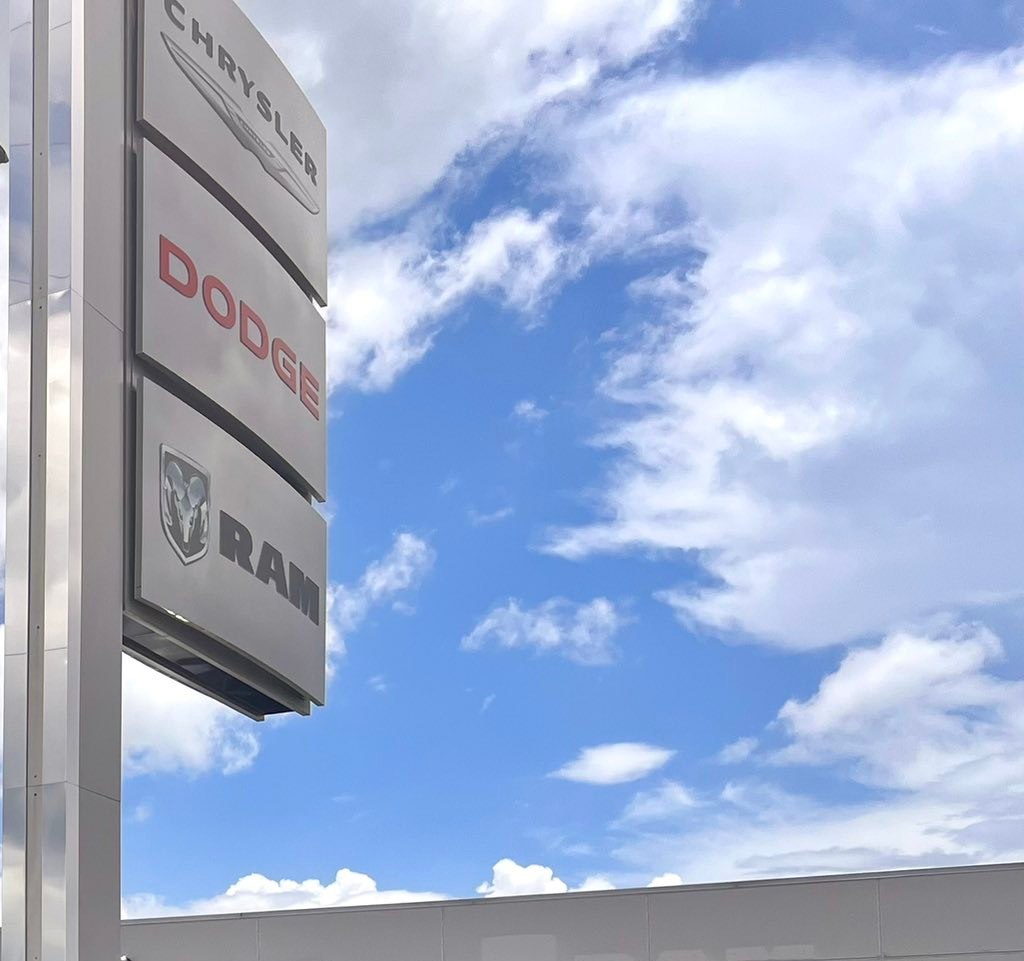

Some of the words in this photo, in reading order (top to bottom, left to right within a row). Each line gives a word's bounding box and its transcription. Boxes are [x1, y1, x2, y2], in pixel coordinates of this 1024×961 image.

[164, 0, 318, 187] CHRYSLER
[159, 234, 320, 421] DODGE
[219, 510, 320, 626] RAM
